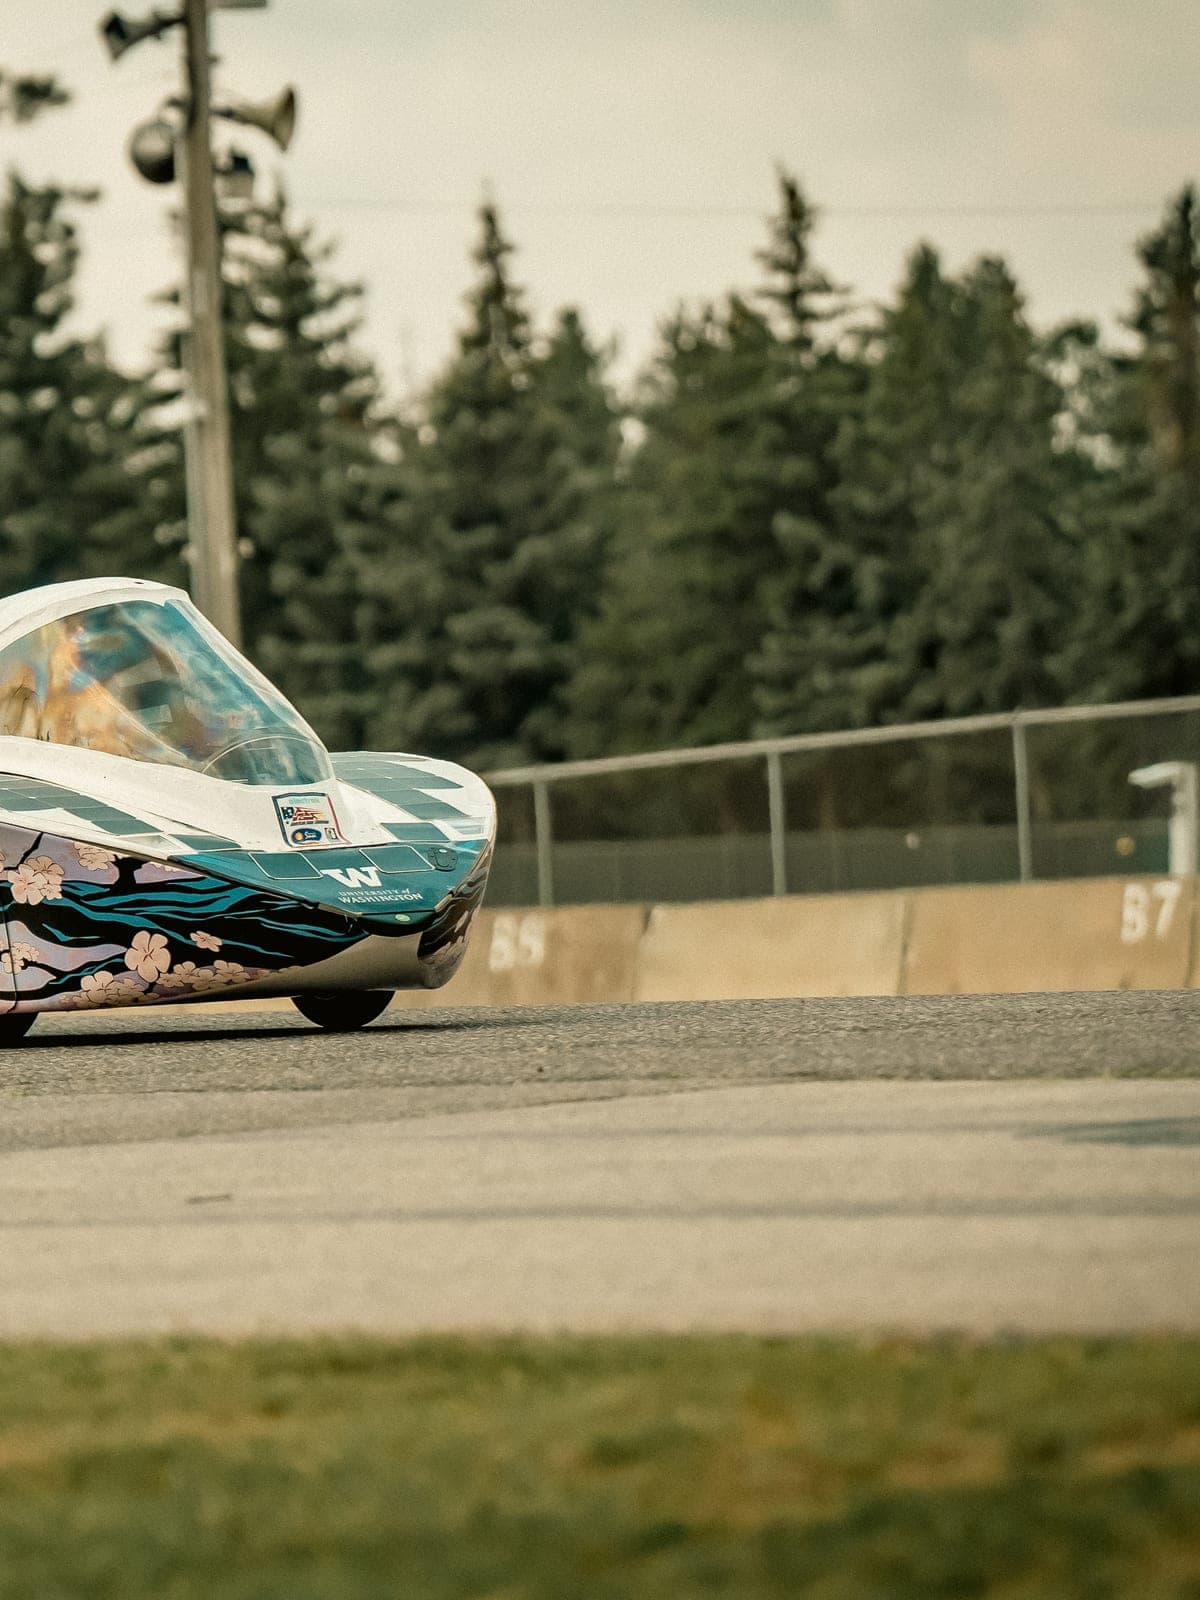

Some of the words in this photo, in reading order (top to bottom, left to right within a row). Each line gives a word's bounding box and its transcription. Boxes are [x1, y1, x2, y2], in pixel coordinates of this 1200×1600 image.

[319, 866, 383, 888] W
[338, 888, 401, 896] UNIVERSITY
[338, 893, 423, 904] WASHINGTON
